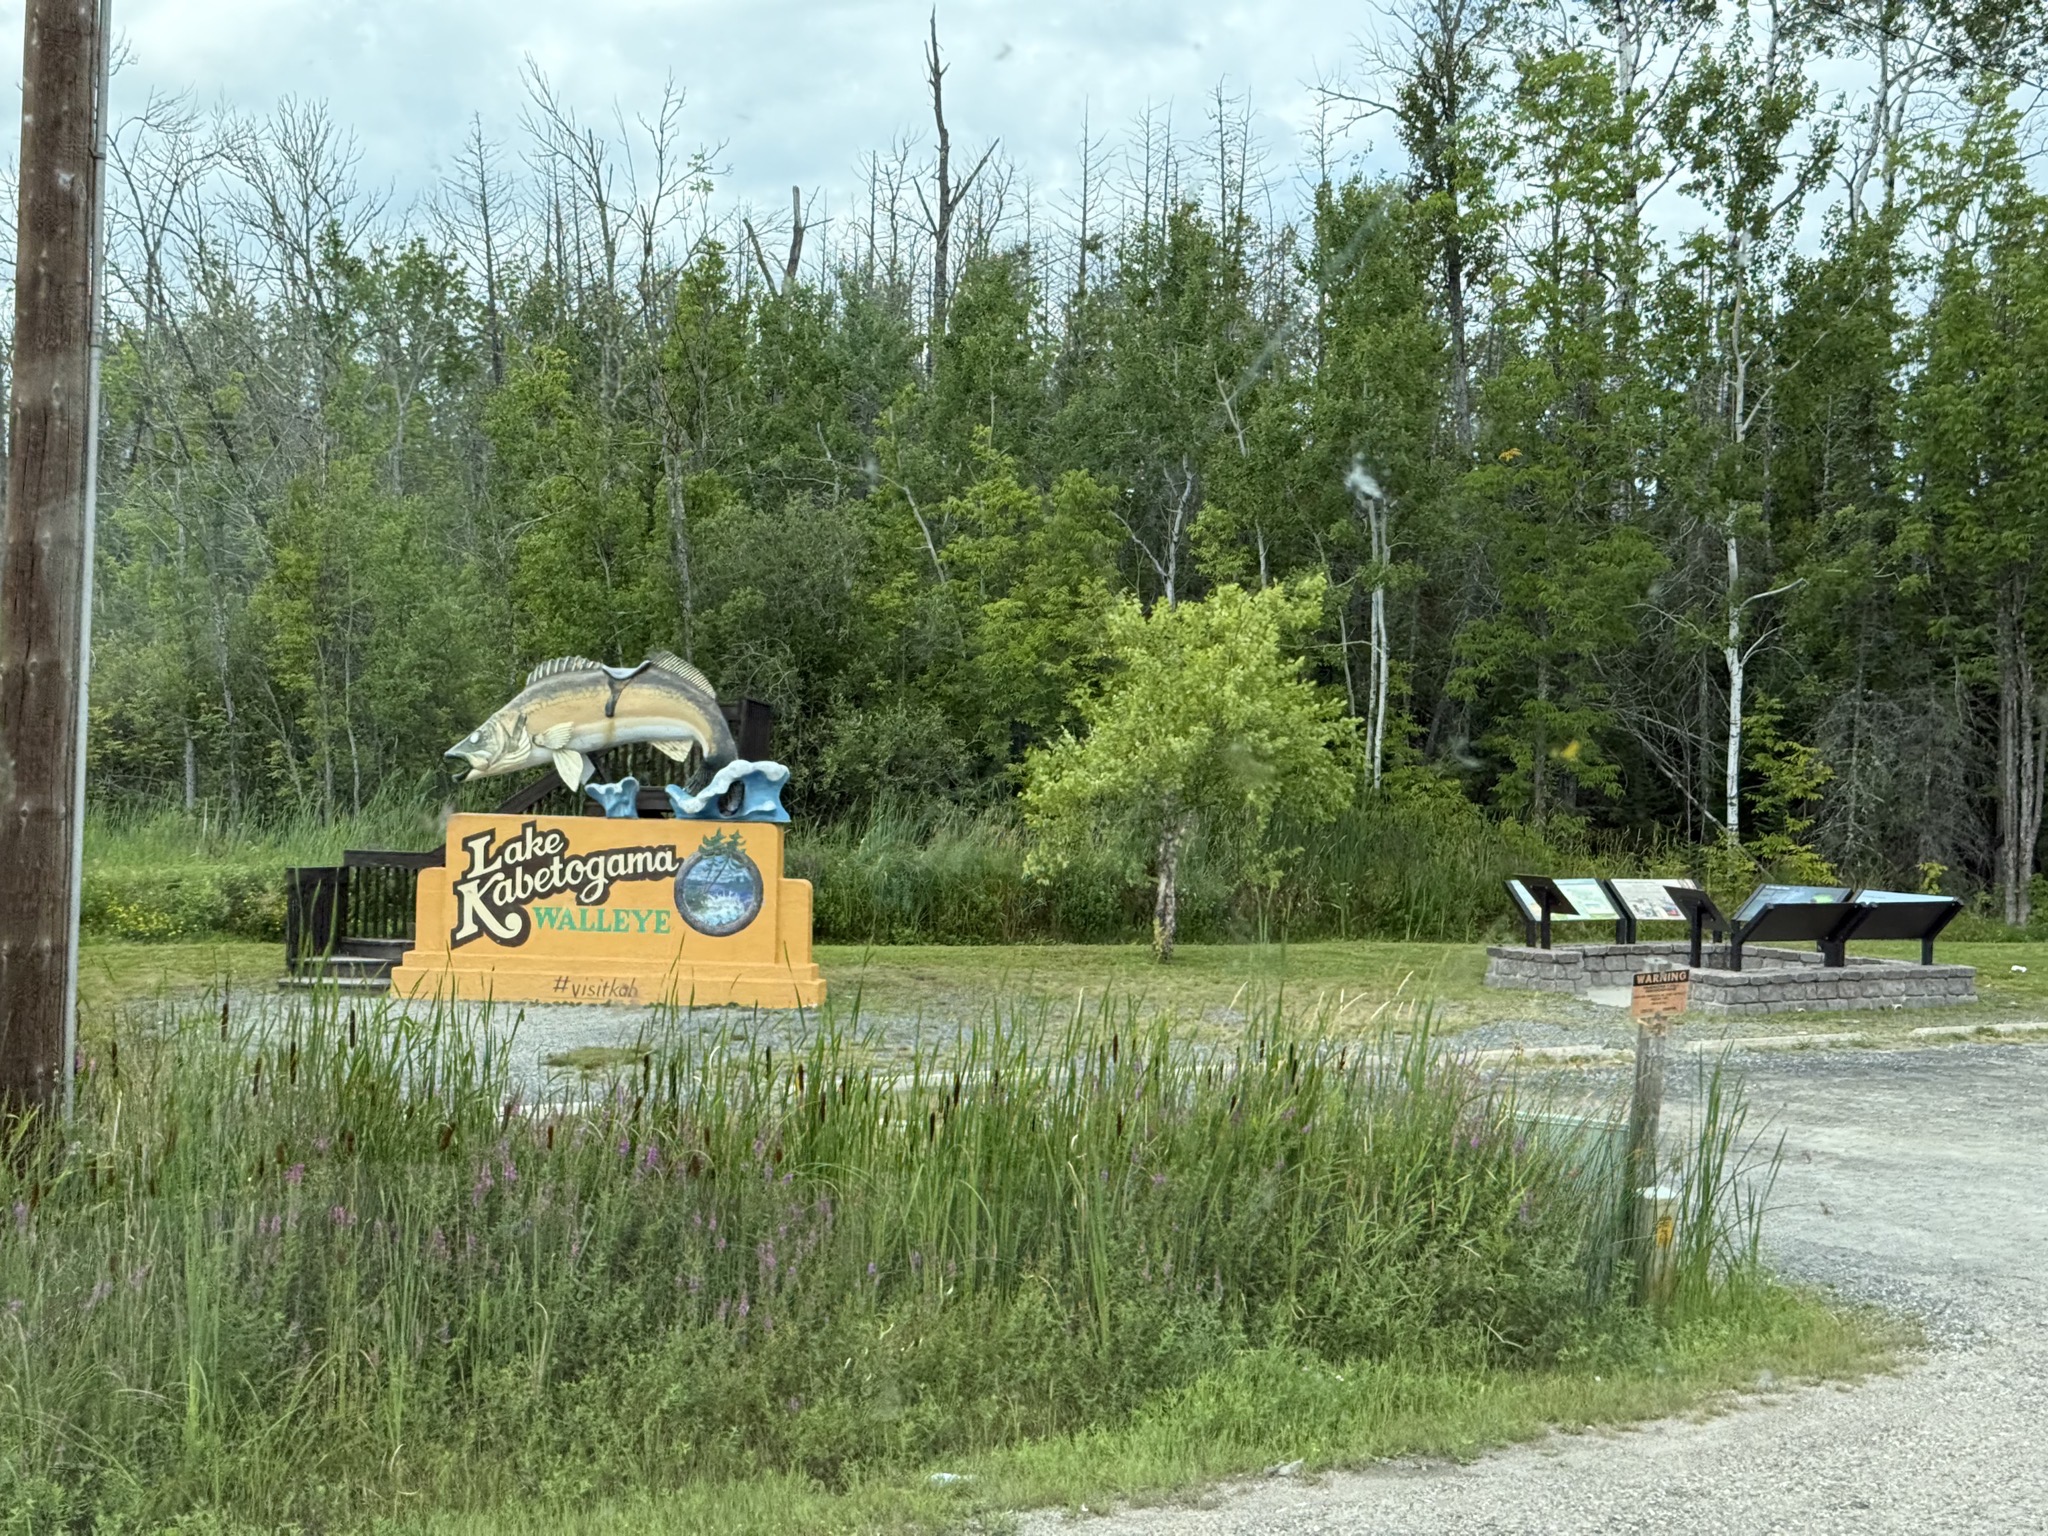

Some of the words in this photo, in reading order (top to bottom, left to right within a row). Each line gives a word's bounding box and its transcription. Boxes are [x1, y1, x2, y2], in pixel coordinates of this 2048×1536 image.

[466, 827, 564, 879] Lake
[456, 850, 679, 940] Kabetogama
[532, 907, 671, 934] WALLEYE
[1636, 971, 1687, 984] WARNING
